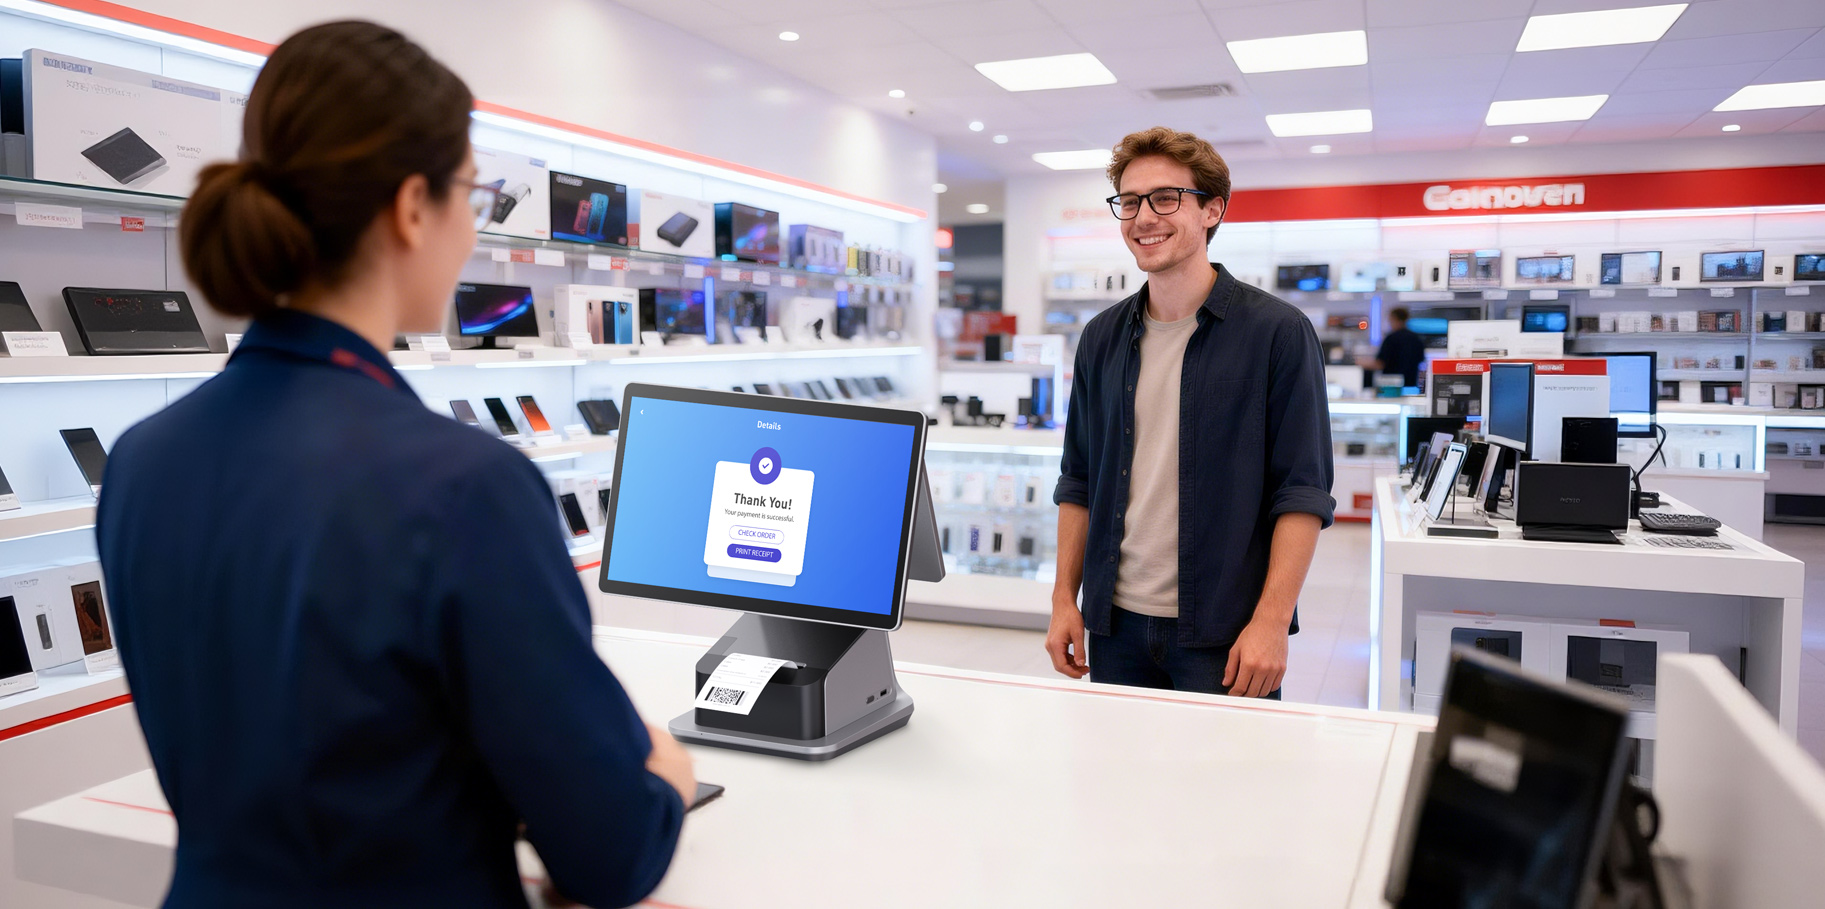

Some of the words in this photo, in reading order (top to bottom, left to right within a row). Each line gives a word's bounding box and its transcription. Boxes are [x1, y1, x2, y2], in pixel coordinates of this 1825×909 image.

[757, 420, 782, 431] Details
[734, 492, 767, 508] Thank
[769, 496, 793, 510] You!
[724, 508, 737, 516] Your
[737, 511, 761, 519] payment
[766, 514, 795, 523] successful.
[737, 529, 757, 537] CHECK
[757, 531, 776, 540] ORDER
[735, 547, 751, 556] PRINT
[751, 549, 774, 558] RECEIPT
